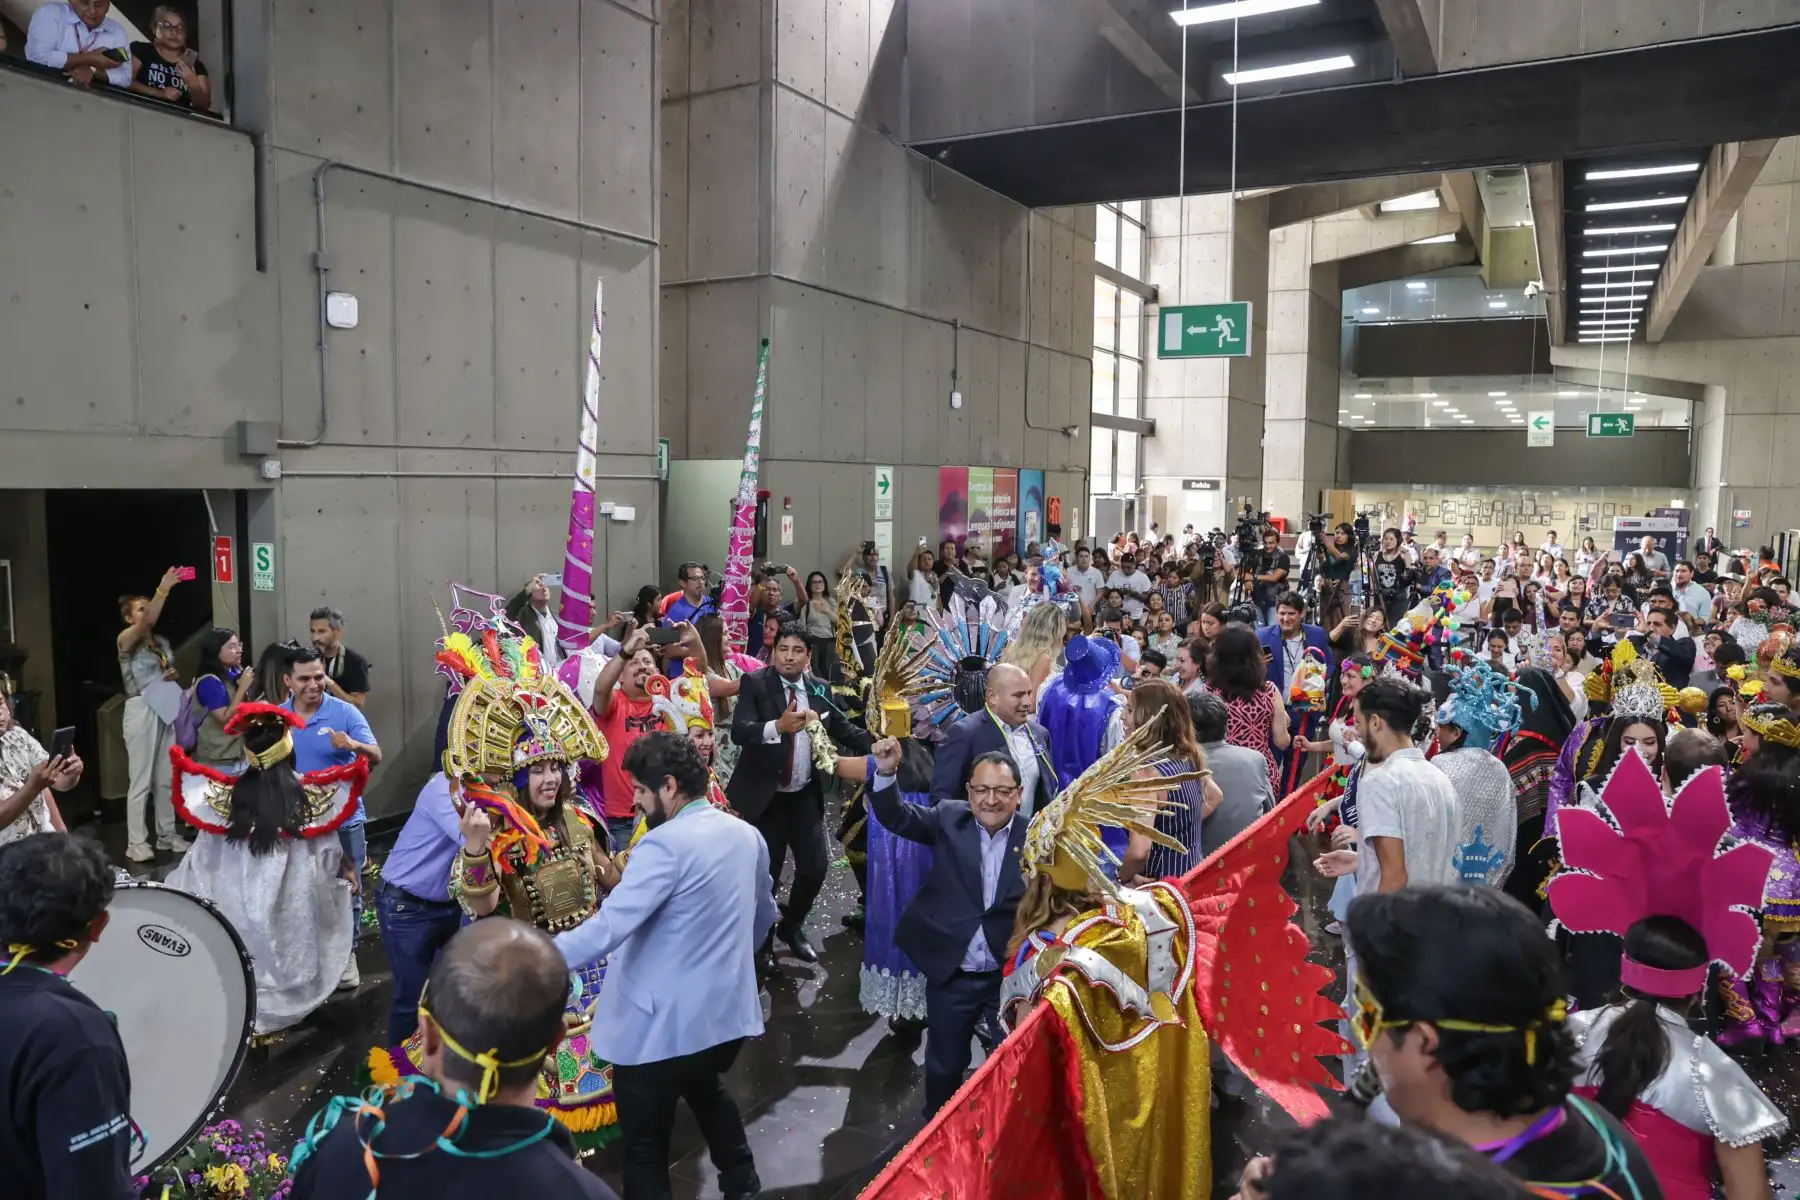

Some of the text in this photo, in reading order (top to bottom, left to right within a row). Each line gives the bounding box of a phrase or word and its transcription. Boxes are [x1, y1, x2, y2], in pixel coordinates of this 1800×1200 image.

[148, 69, 165, 84] NO
[968, 481, 988, 491] Central
[1191, 481, 1210, 489] Salida
[968, 518, 1017, 534] Lenguas Indígenas
[220, 555, 226, 573] 1
[257, 546, 270, 571] S
[143, 929, 186, 954] EVANS
